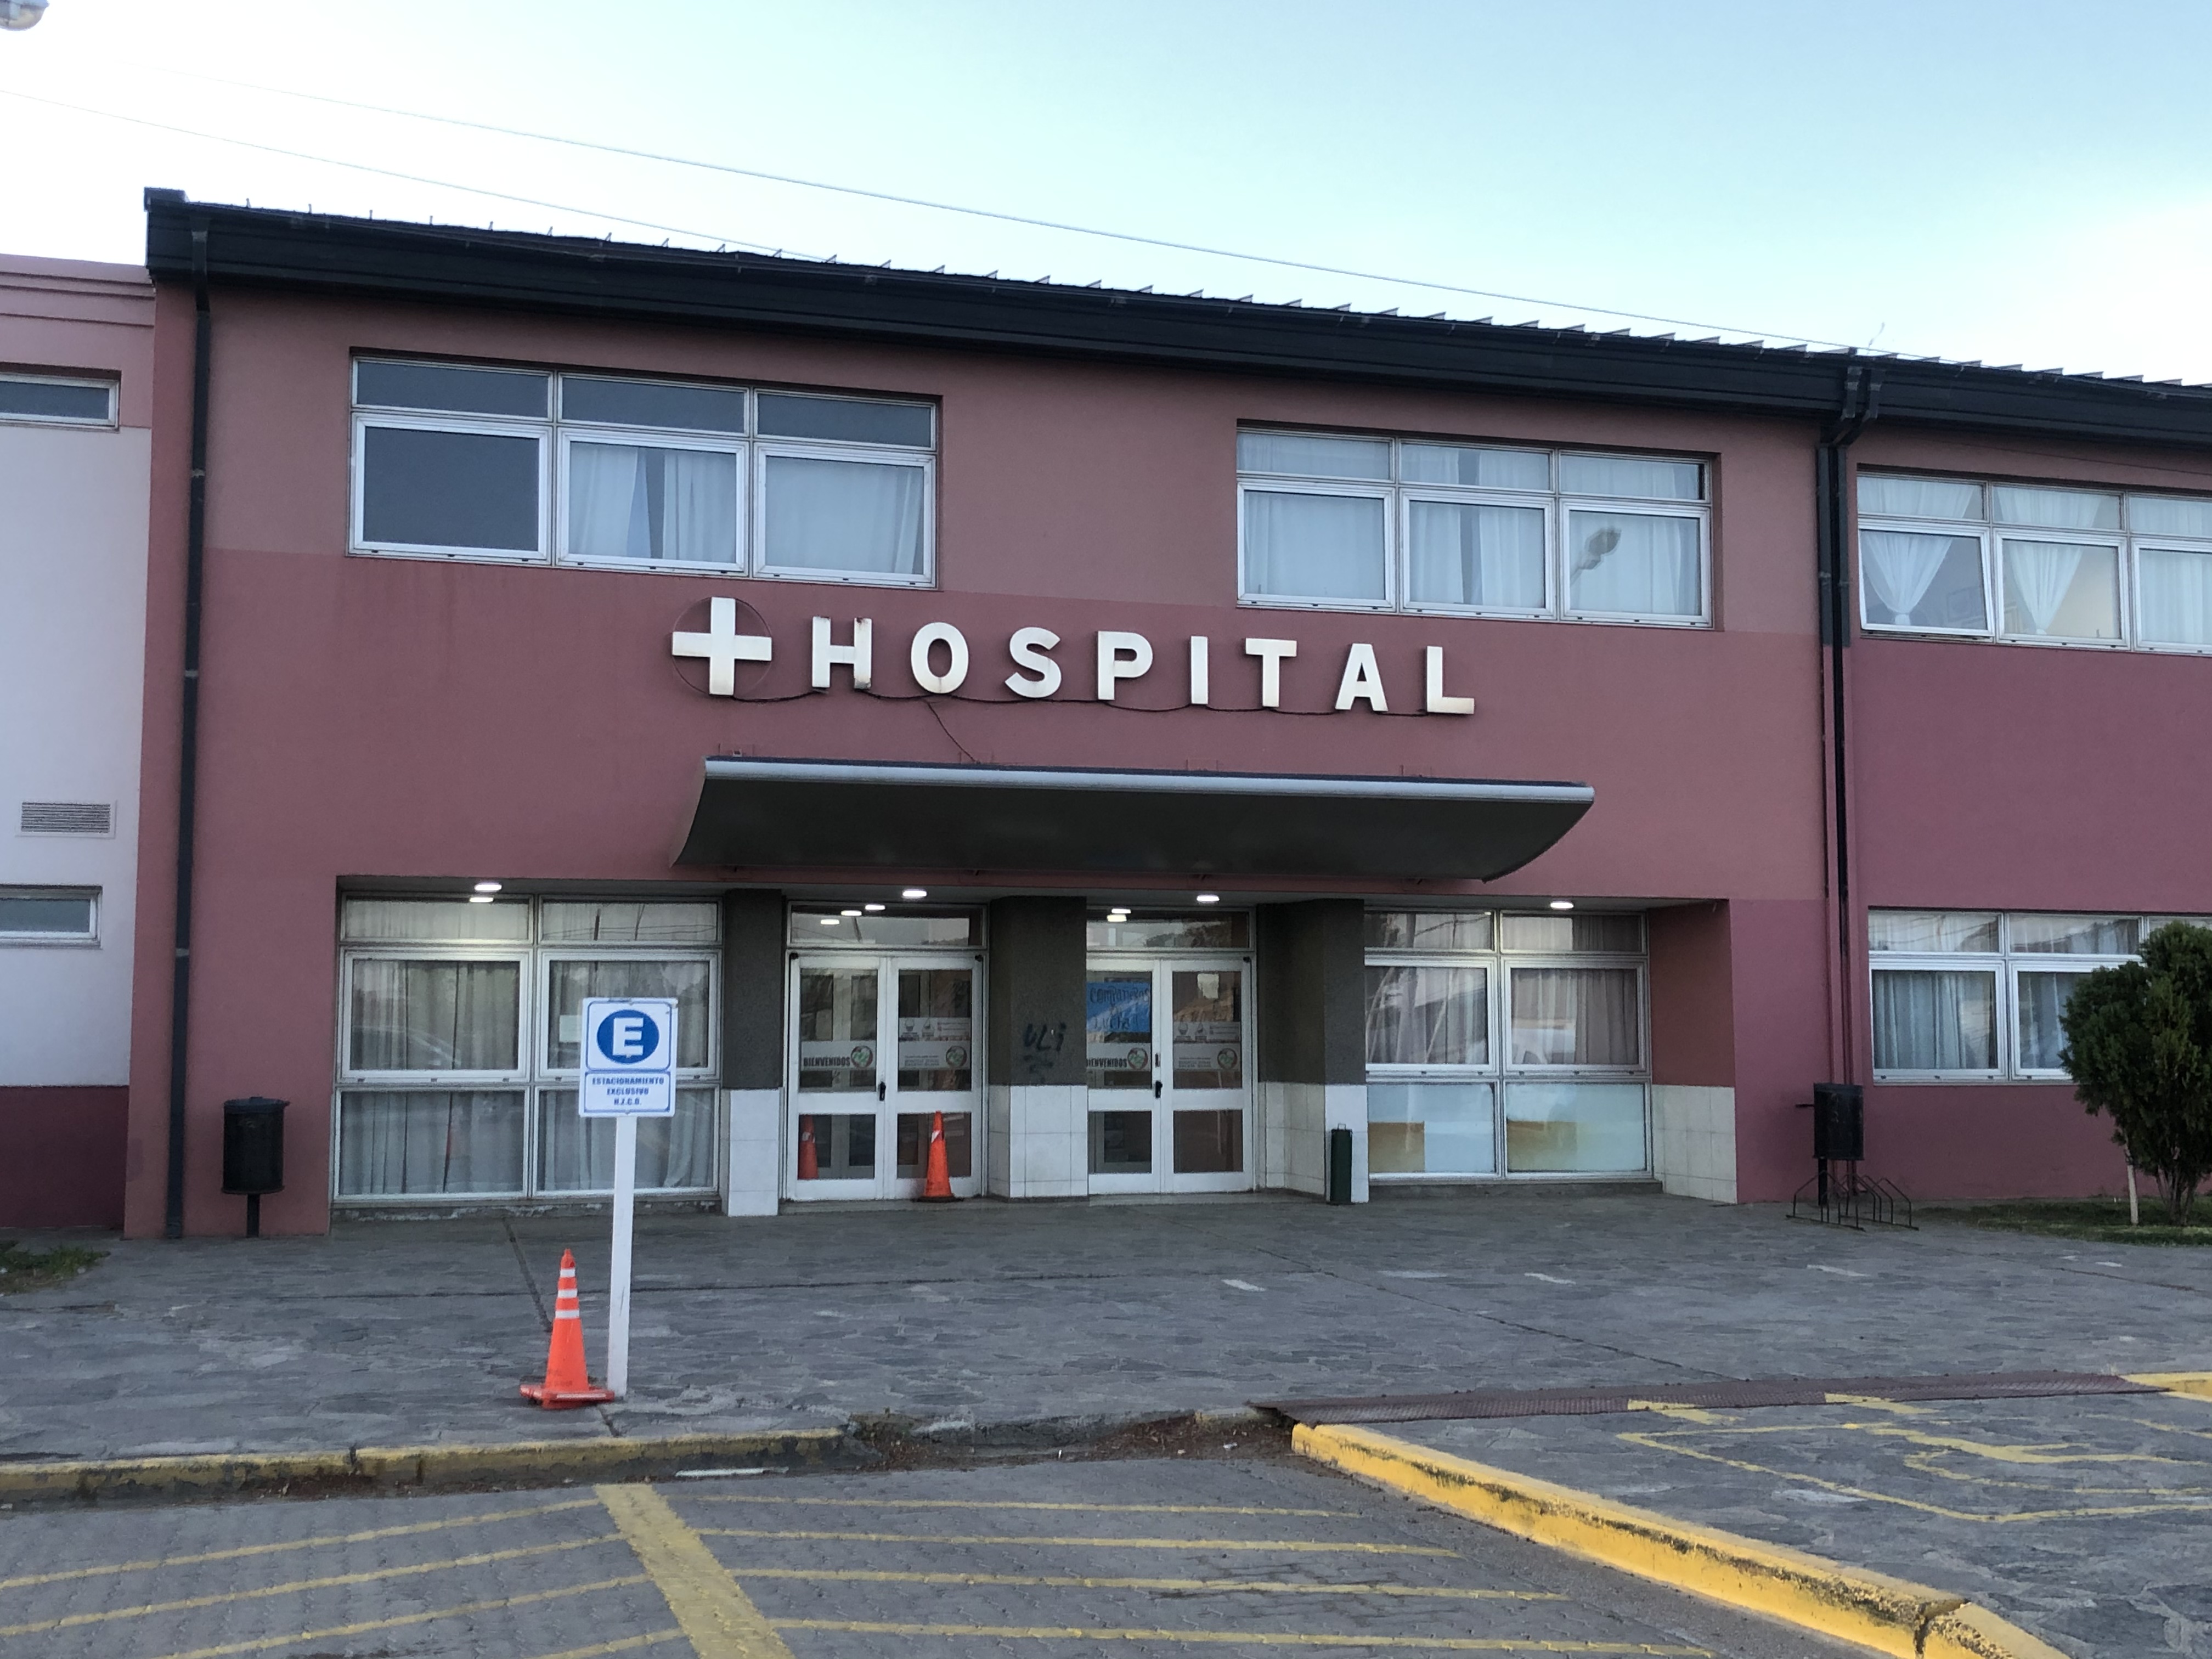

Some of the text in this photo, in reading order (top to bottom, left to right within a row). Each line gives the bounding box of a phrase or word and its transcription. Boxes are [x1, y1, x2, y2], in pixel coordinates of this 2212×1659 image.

[811, 616, 1475, 715] HOSPITAL
[612, 1017, 644, 1057] E
[803, 1056, 850, 1067] BIENVENIDOS
[592, 1077, 664, 1085] ESTACIONAMIENTO
